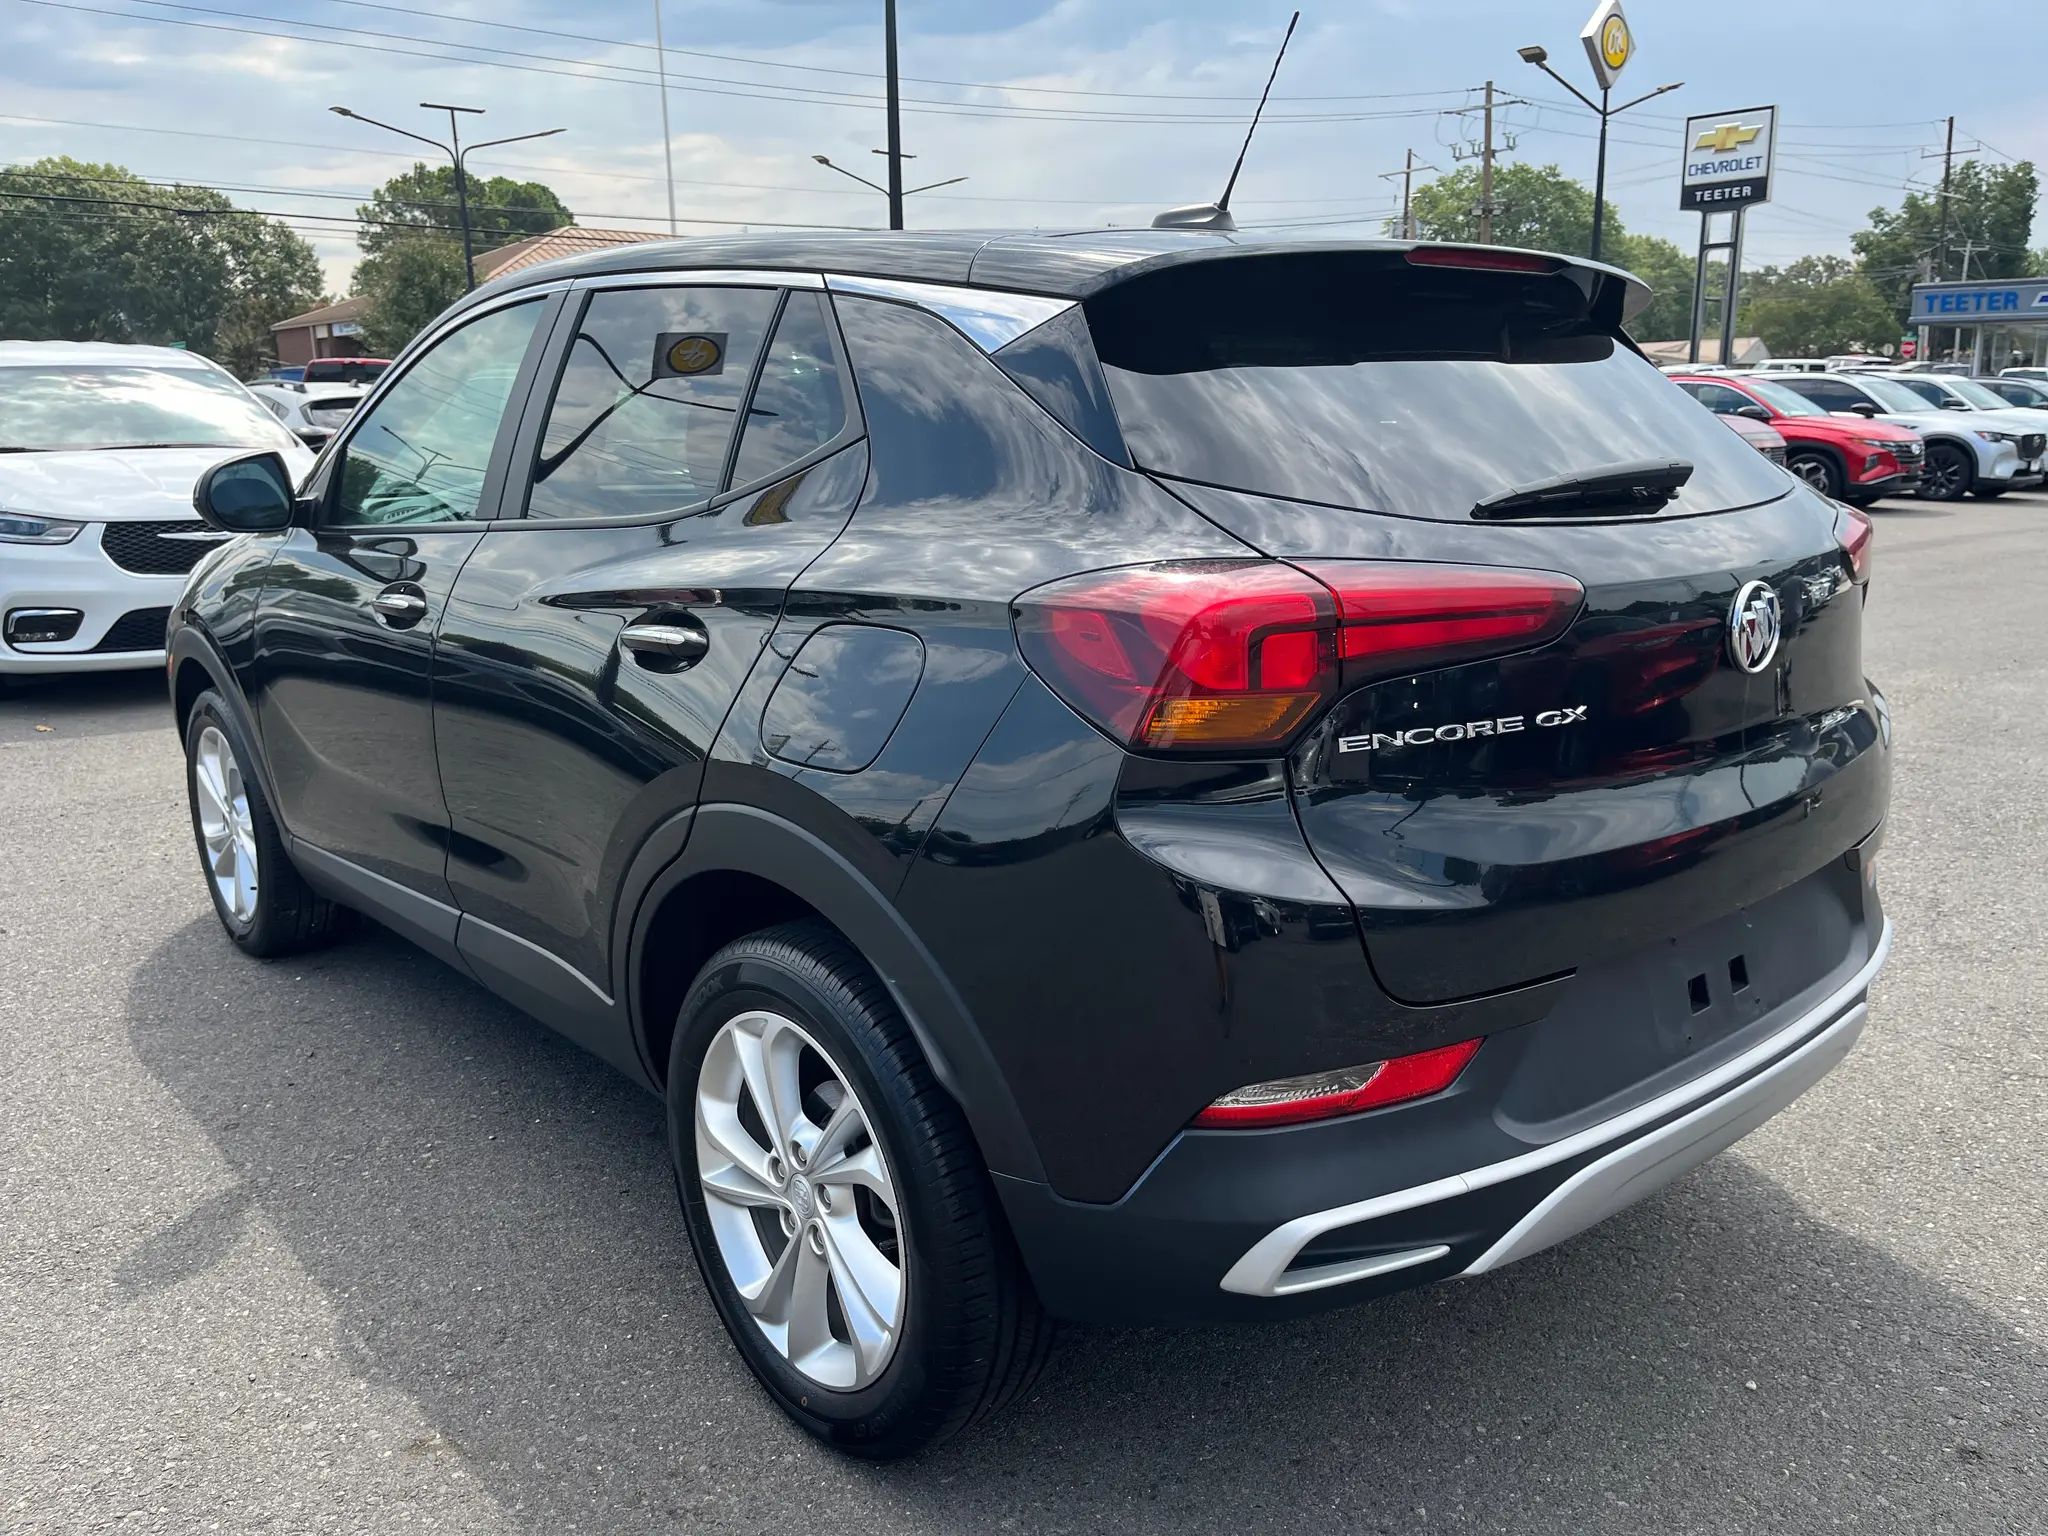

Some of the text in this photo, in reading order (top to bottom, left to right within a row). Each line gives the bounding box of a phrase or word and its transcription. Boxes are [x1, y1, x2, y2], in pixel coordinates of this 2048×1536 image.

[1607, 26, 1624, 55] OK
[1688, 156, 1763, 176] CHEVROLET
[1695, 186, 1752, 202] TEETER
[1924, 291, 2019, 313] TEETER
[1338, 705, 1588, 754] ENCORE GX
